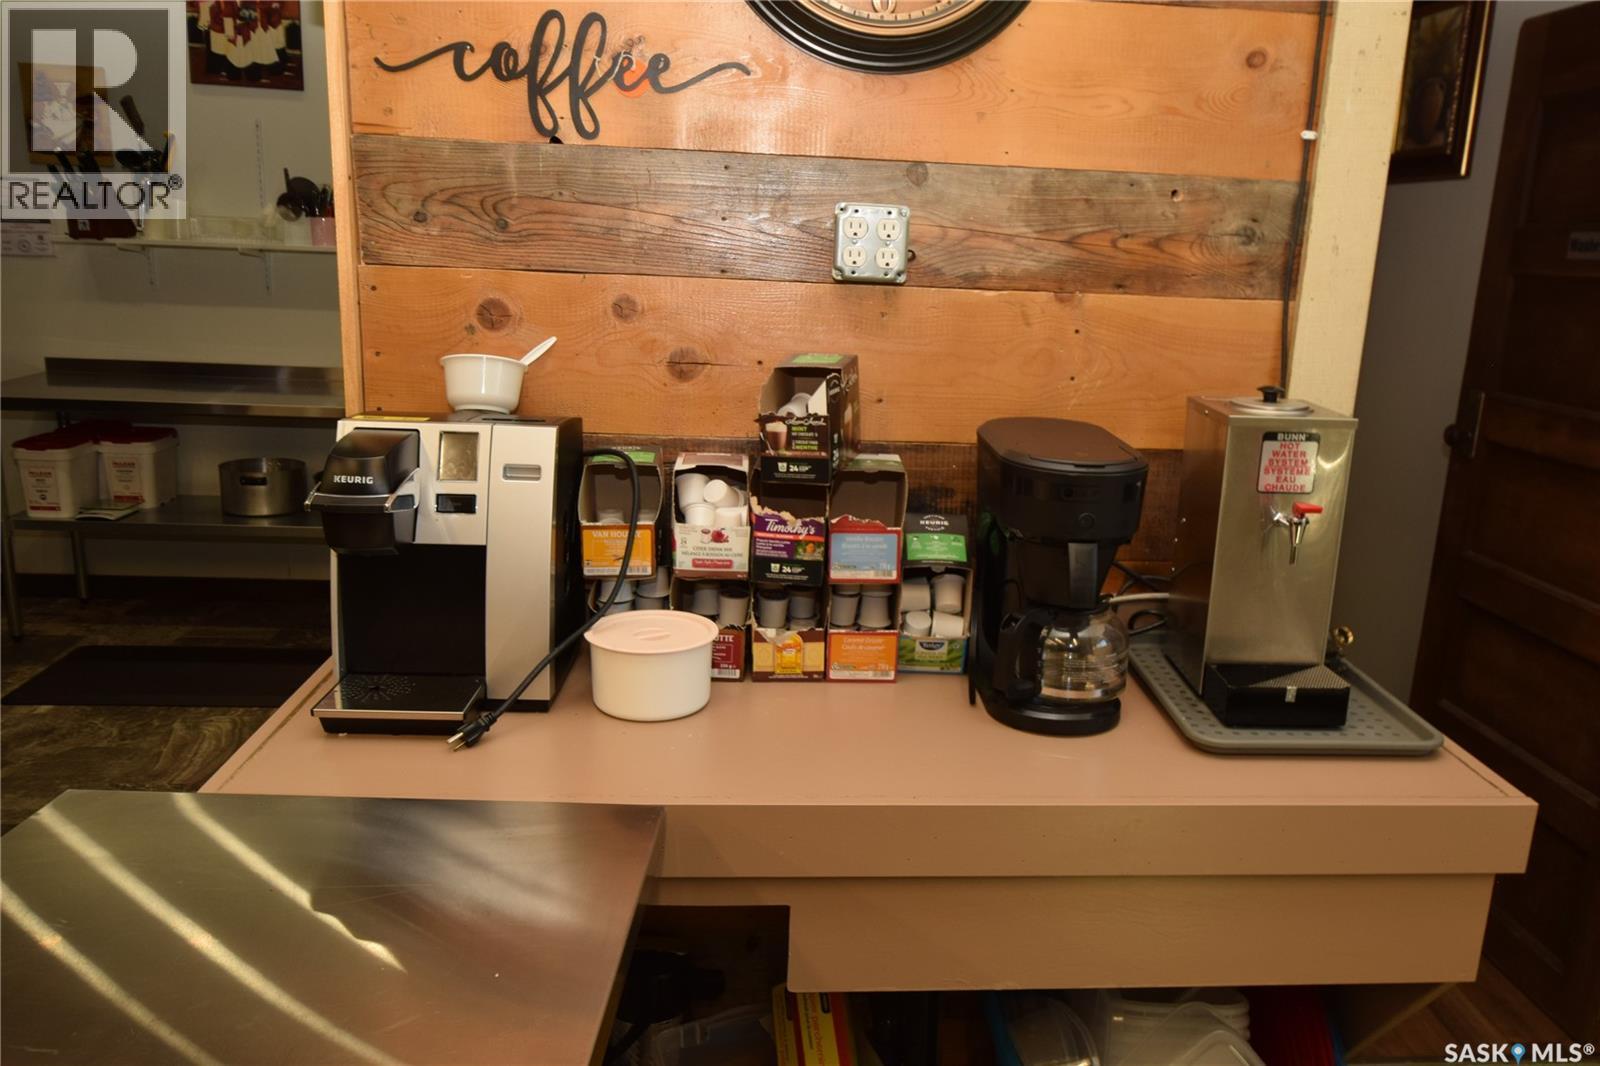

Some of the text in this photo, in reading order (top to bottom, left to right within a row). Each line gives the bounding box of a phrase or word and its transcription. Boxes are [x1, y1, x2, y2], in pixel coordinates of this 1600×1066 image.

[375, 9, 751, 139] coffee
[1277, 433, 1306, 441] BUNN
[1272, 450, 1306, 458] WATER
[1268, 458, 1308, 466] SYSTEM
[333, 474, 374, 484] KEURIG
[1264, 483, 1306, 492] CHAUDE
[765, 518, 815, 539] Timothy's
[592, 530, 608, 538] VAN
